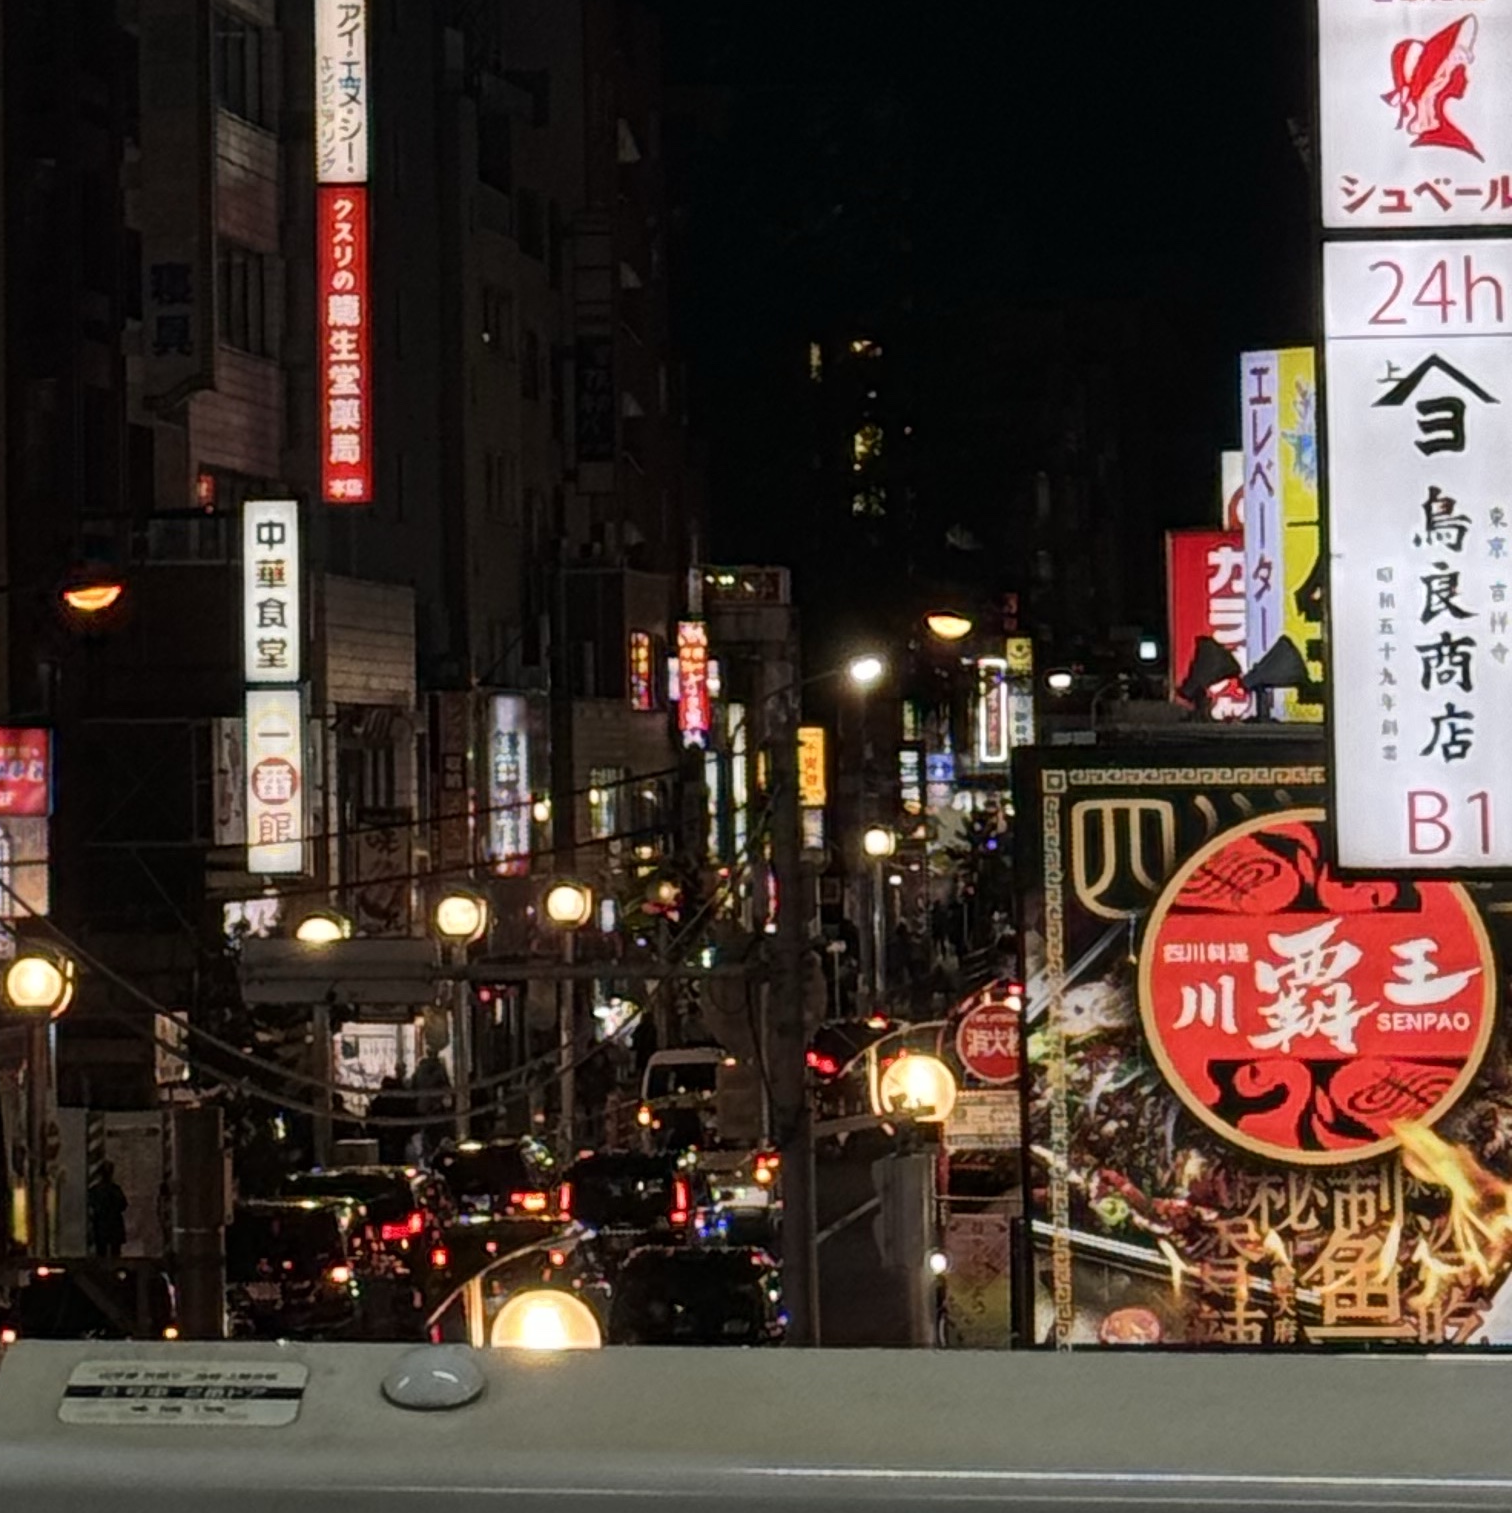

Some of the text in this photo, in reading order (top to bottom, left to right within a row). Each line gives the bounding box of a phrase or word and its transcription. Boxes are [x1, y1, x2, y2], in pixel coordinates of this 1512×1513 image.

[1341, 175, 1512, 214] シュベール
[1368, 254, 1504, 325] 24h
[1248, 366, 1275, 652] エレベーター
[255, 520, 289, 669] 中華食堂
[1412, 484, 1480, 764] 鳥良商店
[1405, 789, 1493, 856] B1
[1376, 1012, 1471, 1032] SENPAO
